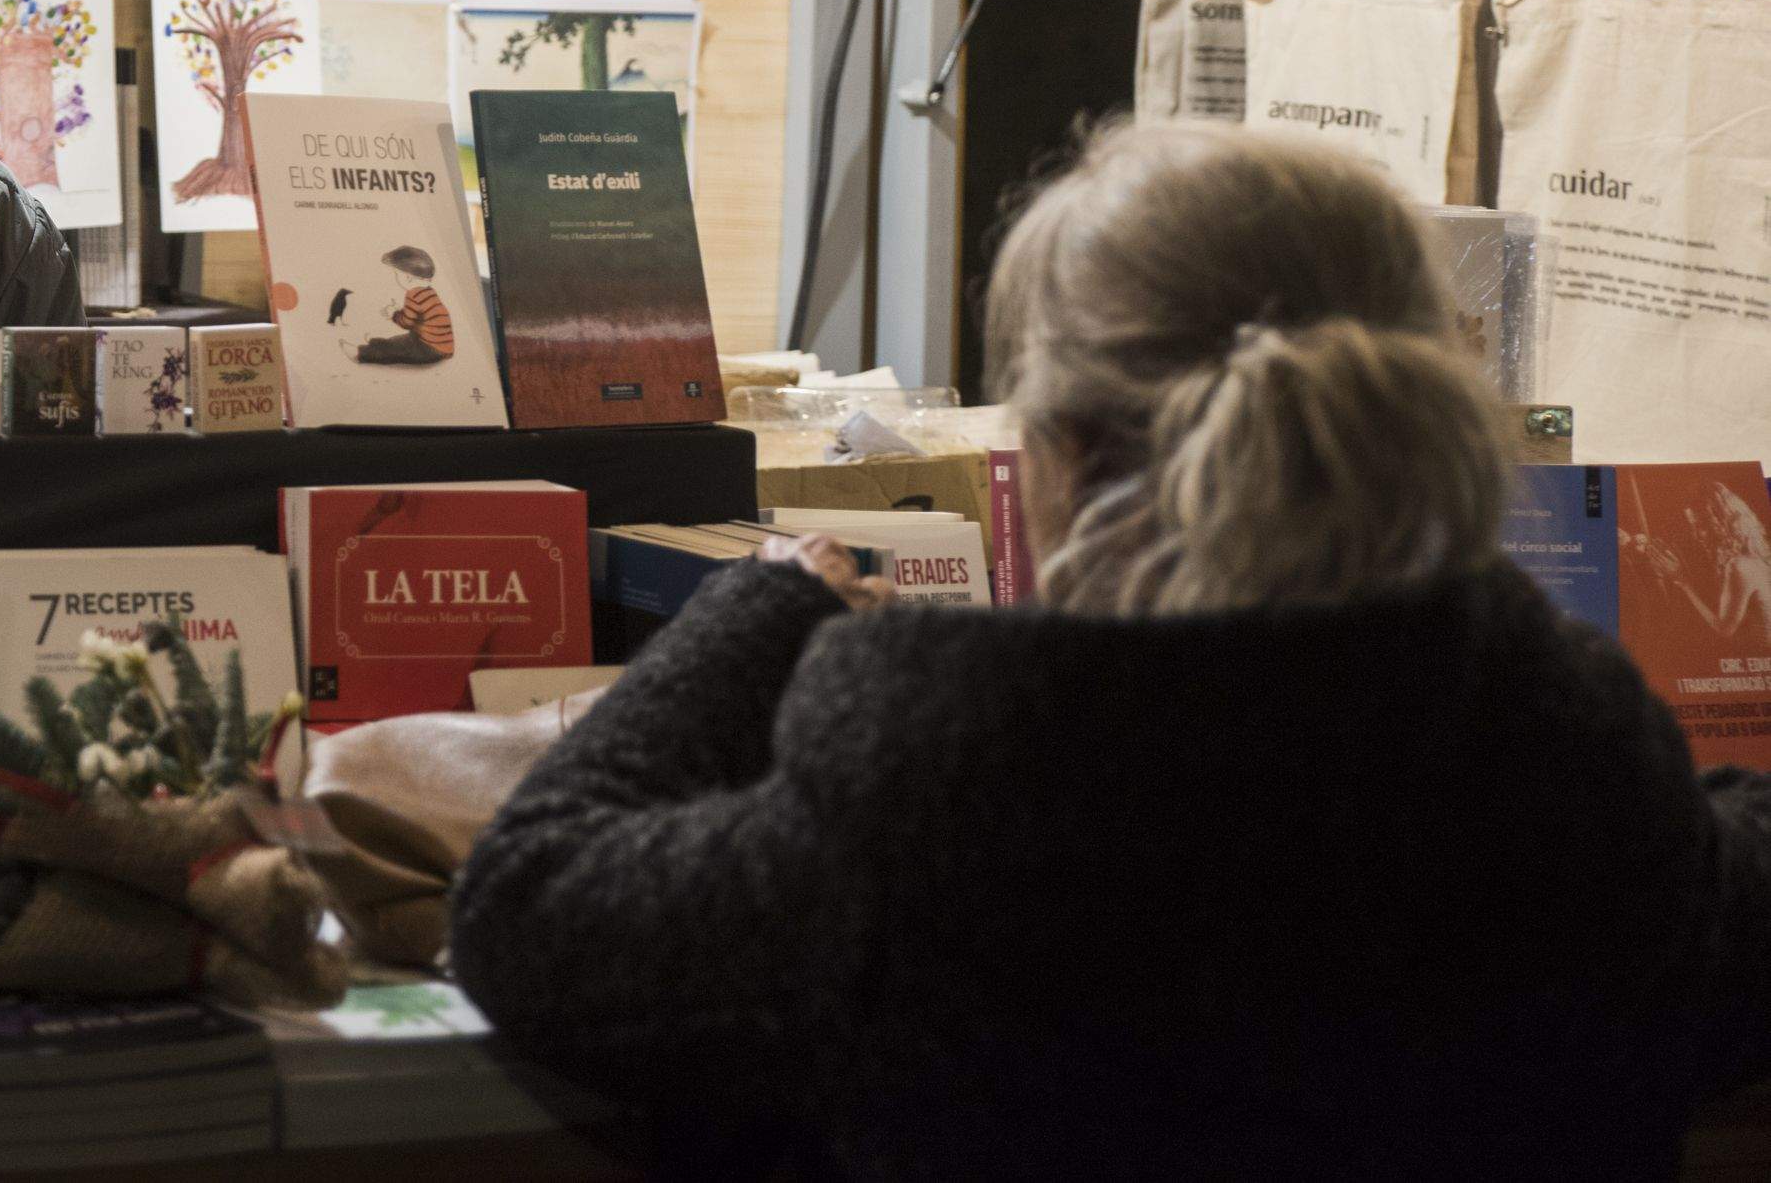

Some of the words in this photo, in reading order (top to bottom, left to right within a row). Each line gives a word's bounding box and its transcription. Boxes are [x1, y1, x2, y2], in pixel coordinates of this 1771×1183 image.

[303, 133, 330, 157] DE
[335, 134, 369, 158] QUI
[374, 132, 416, 160] SÓN
[538, 132, 566, 144] Judith
[288, 166, 326, 189] ELS
[332, 168, 436, 194] INFANTS?
[547, 173, 590, 189] Estat
[592, 171, 641, 190] d'exili
[1548, 168, 1633, 200] cuidar
[112, 339, 145, 352] TAO
[208, 346, 275, 366] LORCA
[112, 353, 130, 366] TE
[112, 366, 153, 379] KING
[208, 396, 274, 420] GITANO
[1520, 540, 1548, 554] circo
[1549, 540, 1583, 554] social
[894, 557, 969, 586] NERADES
[364, 570, 417, 604] LA
[422, 570, 531, 604] TELA
[895, 592, 929, 603] RCELONA
[29, 594, 60, 646] 7
[65, 591, 196, 615] RECEPTES
[182, 618, 239, 641] NIMA
